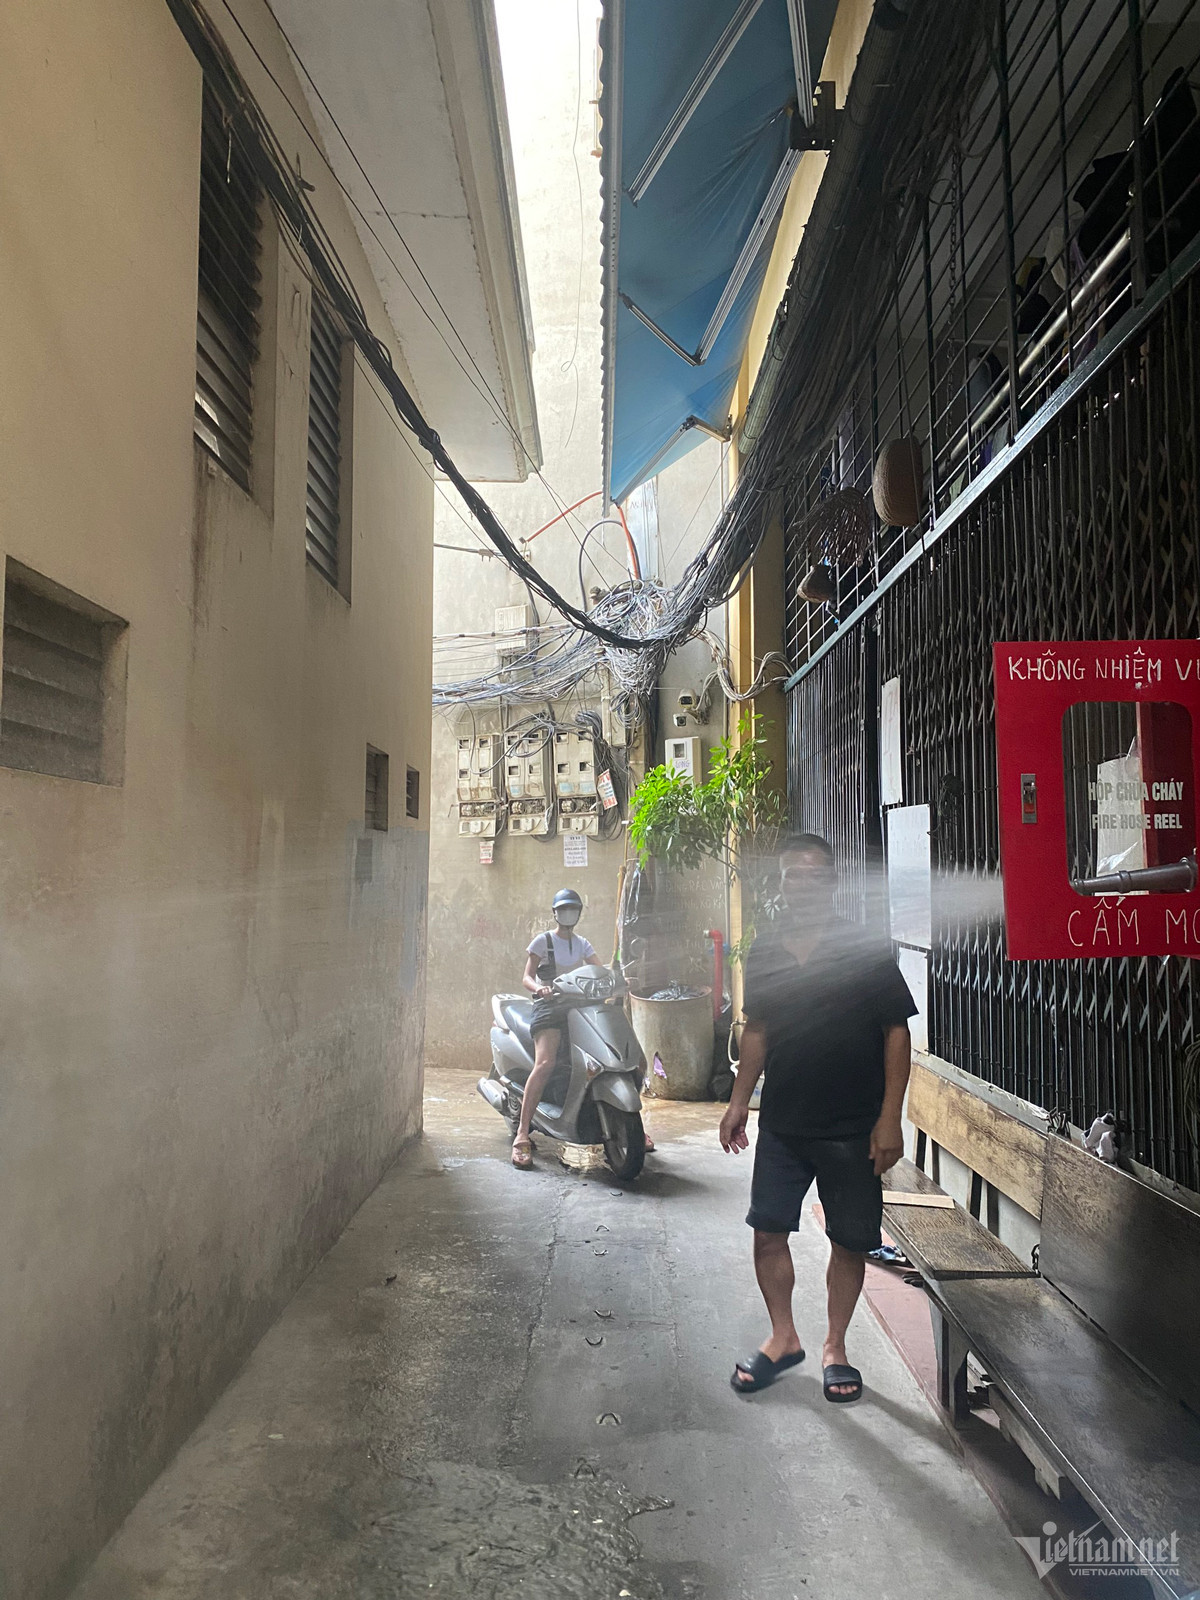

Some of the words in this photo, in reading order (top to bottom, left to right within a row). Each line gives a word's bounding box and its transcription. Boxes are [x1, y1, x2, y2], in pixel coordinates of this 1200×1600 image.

[1008, 648, 1086, 682] KHÔNG
[1088, 779, 1113, 805] HỘP
[1152, 778, 1184, 802] CHÁY
[1092, 813, 1117, 830] FIRE
[1120, 813, 1151, 830] HOSE
[1154, 813, 1183, 830] REEL
[1067, 896, 1140, 947] CẤM
